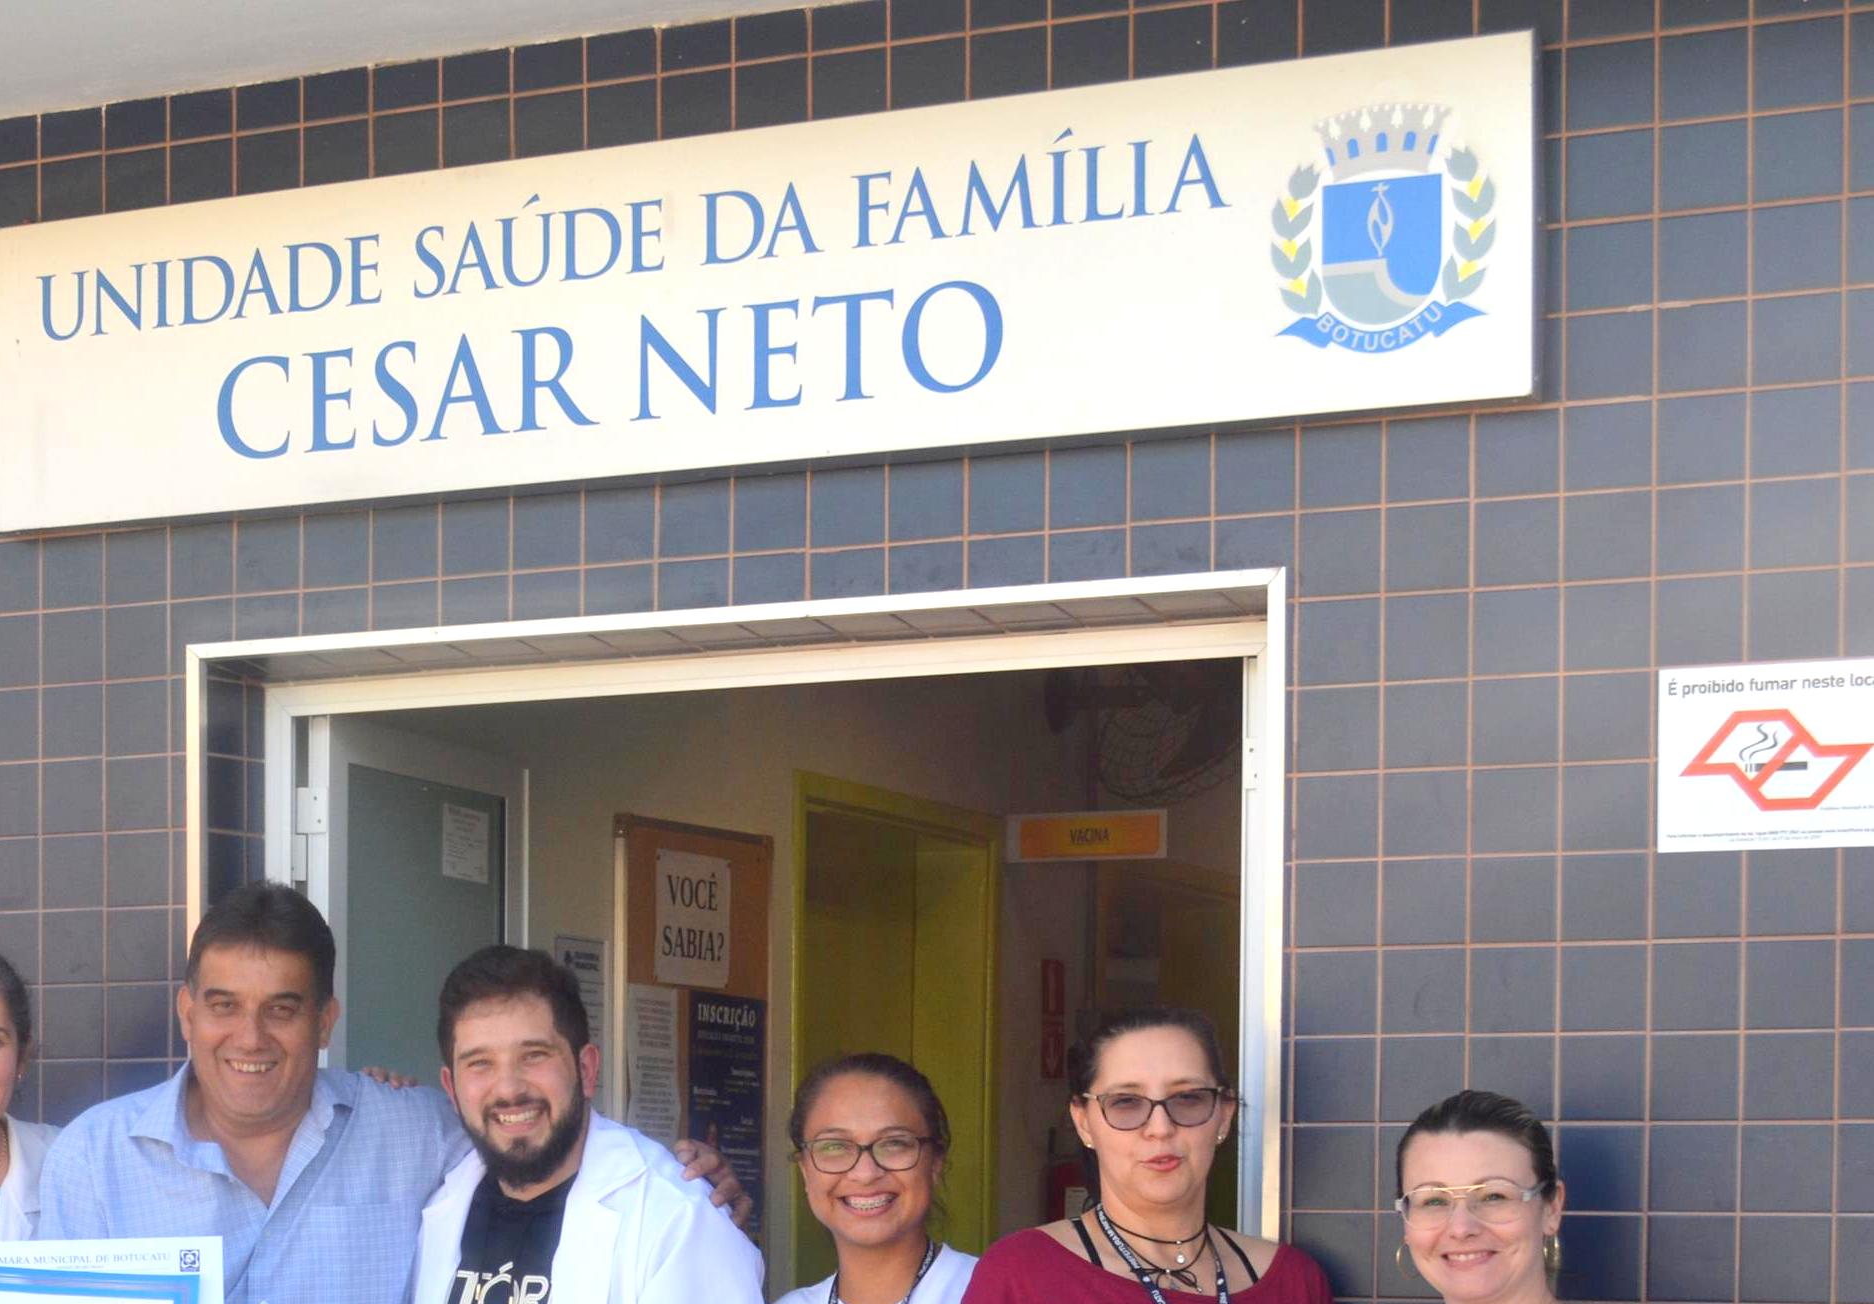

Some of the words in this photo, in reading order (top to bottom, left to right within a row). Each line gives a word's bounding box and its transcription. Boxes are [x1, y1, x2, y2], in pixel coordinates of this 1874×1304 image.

[38, 236, 380, 341] UNIDADE
[414, 193, 665, 299] SAÚDE
[703, 184, 819, 266] DA
[851, 129, 1229, 249] FAMÍLIA
[1315, 302, 1443, 351] BOTUCATU
[217, 326, 598, 459] CESAR
[636, 280, 1005, 421] NETO
[1668, 677, 1678, 696] É
[1682, 679, 1744, 698] proibido
[1749, 676, 1797, 692] fumar
[1802, 674, 1846, 690] neste
[1069, 827, 1111, 844] VACINA
[667, 872, 718, 911] VOCÊ
[662, 925, 724, 962] SABIA?
[697, 1003, 757, 1031] INSCRIÇÃO
[33, 1254, 92, 1265] MUNICIPAL
[95, 1254, 110, 1263] DE
[113, 1252, 171, 1262] BOTUCATU
